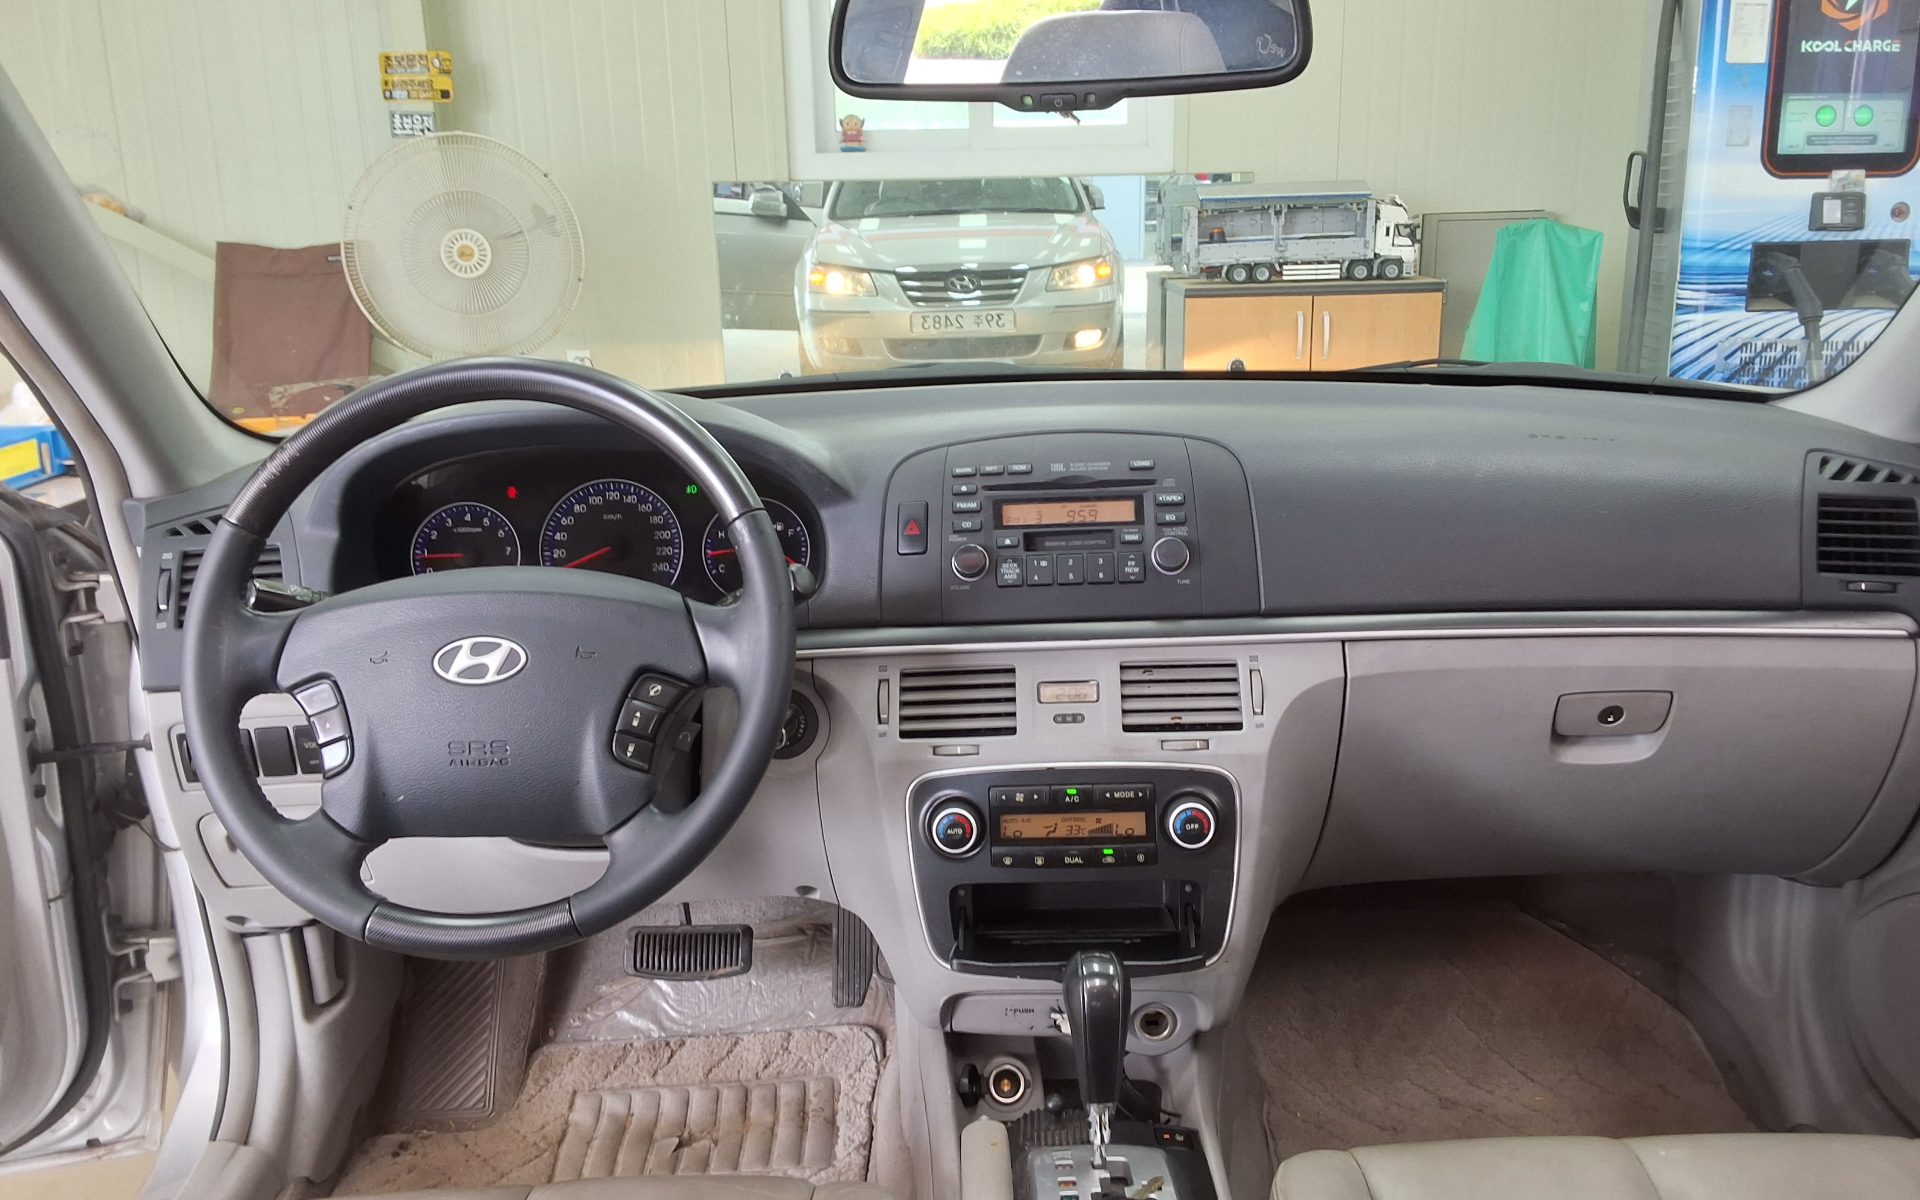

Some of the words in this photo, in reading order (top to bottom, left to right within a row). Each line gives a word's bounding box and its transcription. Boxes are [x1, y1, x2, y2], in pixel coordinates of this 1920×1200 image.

[1801, 40, 1842, 52] KOOL
[1844, 39, 1901, 52] CHARGE
[588, 496, 603, 505] 100
[606, 492, 620, 500] 120
[623, 495, 638, 504] 140
[574, 504, 587, 514] 80
[638, 504, 652, 512] 160
[464, 512, 472, 522] 4
[483, 517, 490, 526] 5
[560, 516, 574, 526] 60
[650, 516, 664, 524] 180
[1166, 514, 1176, 522] EQ
[446, 518, 452, 527] 3
[430, 530, 438, 540] 2
[498, 529, 504, 538] 6
[554, 532, 568, 541] 40
[654, 530, 671, 540] 200
[718, 530, 725, 538] H
[788, 529, 794, 537] F
[424, 548, 428, 556] 1
[505, 546, 512, 556] 7
[553, 549, 566, 559] 20
[656, 547, 673, 556] 220
[652, 564, 670, 572] 240
[718, 564, 726, 573] C
[448, 740, 511, 756] SRS
[449, 758, 512, 767] AIRBAG
[1064, 856, 1084, 864] DUAL
